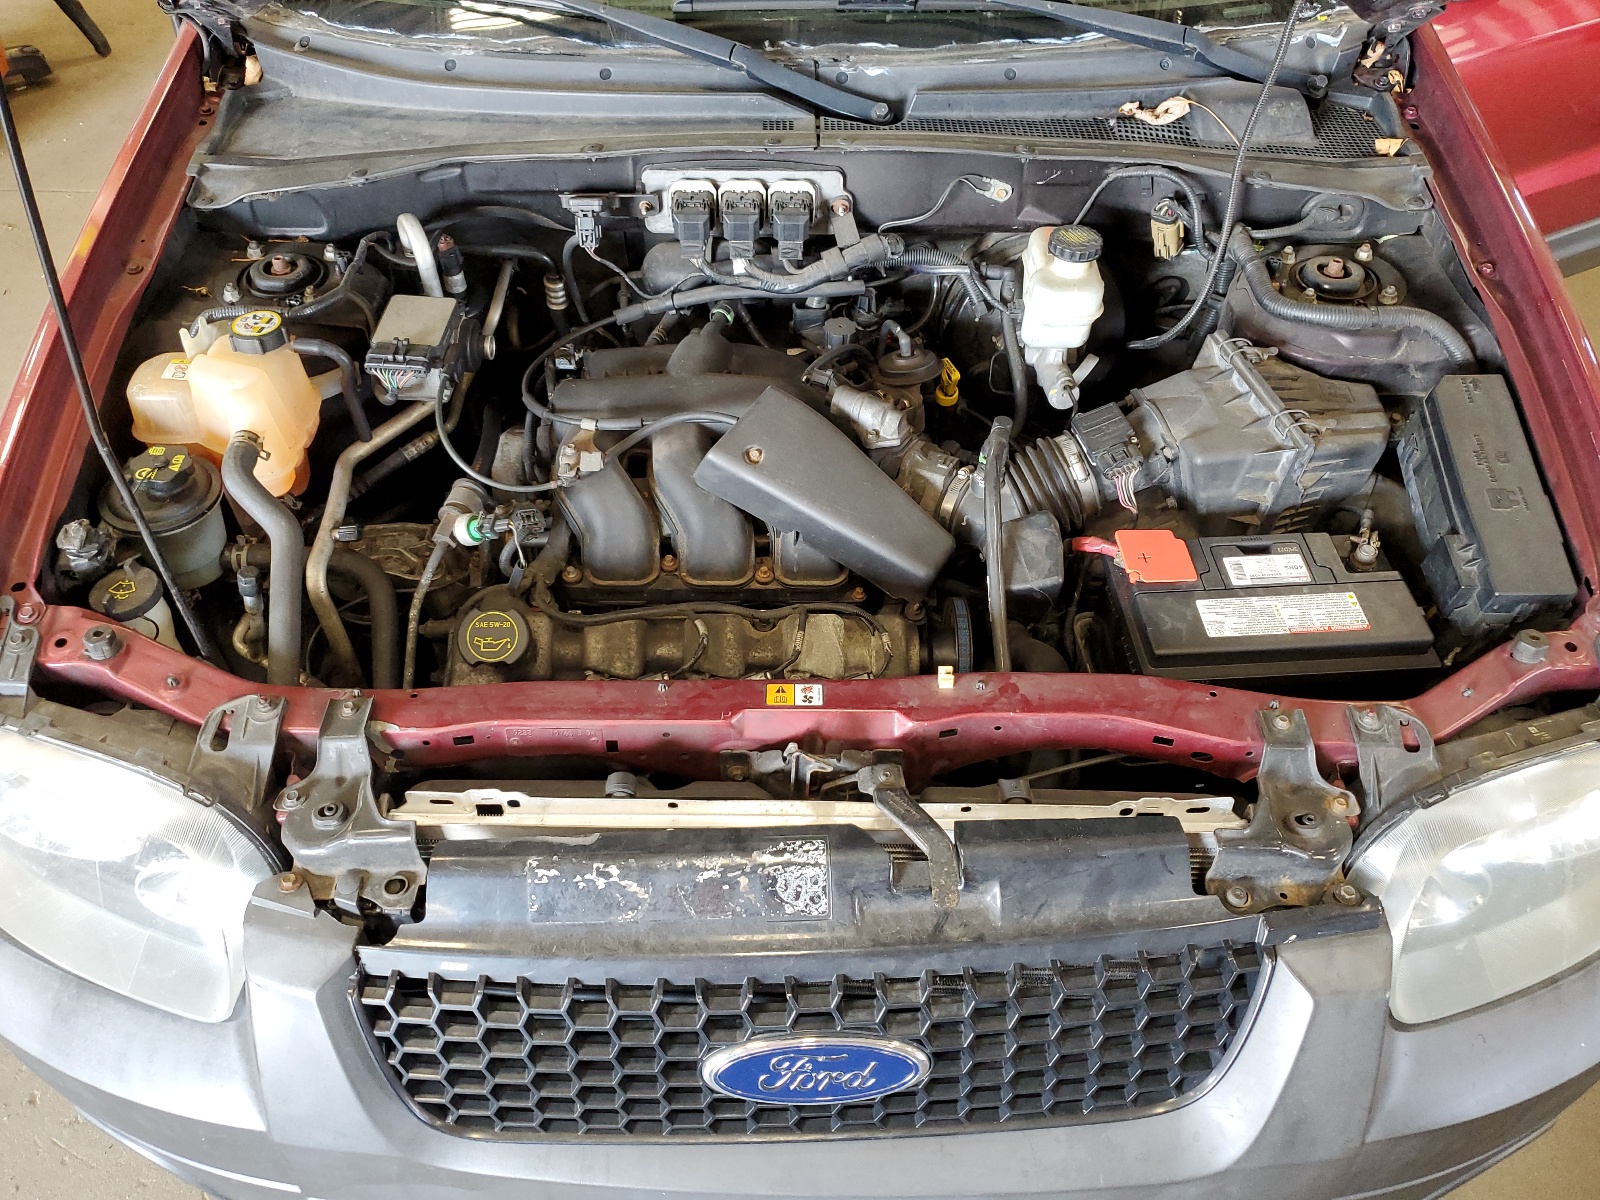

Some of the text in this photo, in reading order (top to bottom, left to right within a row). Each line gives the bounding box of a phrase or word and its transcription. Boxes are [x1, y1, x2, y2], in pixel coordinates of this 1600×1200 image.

[1473, 450, 1485, 466] FUSE
[1473, 434, 1498, 483] COMPARTMENT
[758, 1053, 879, 1092] Ford
